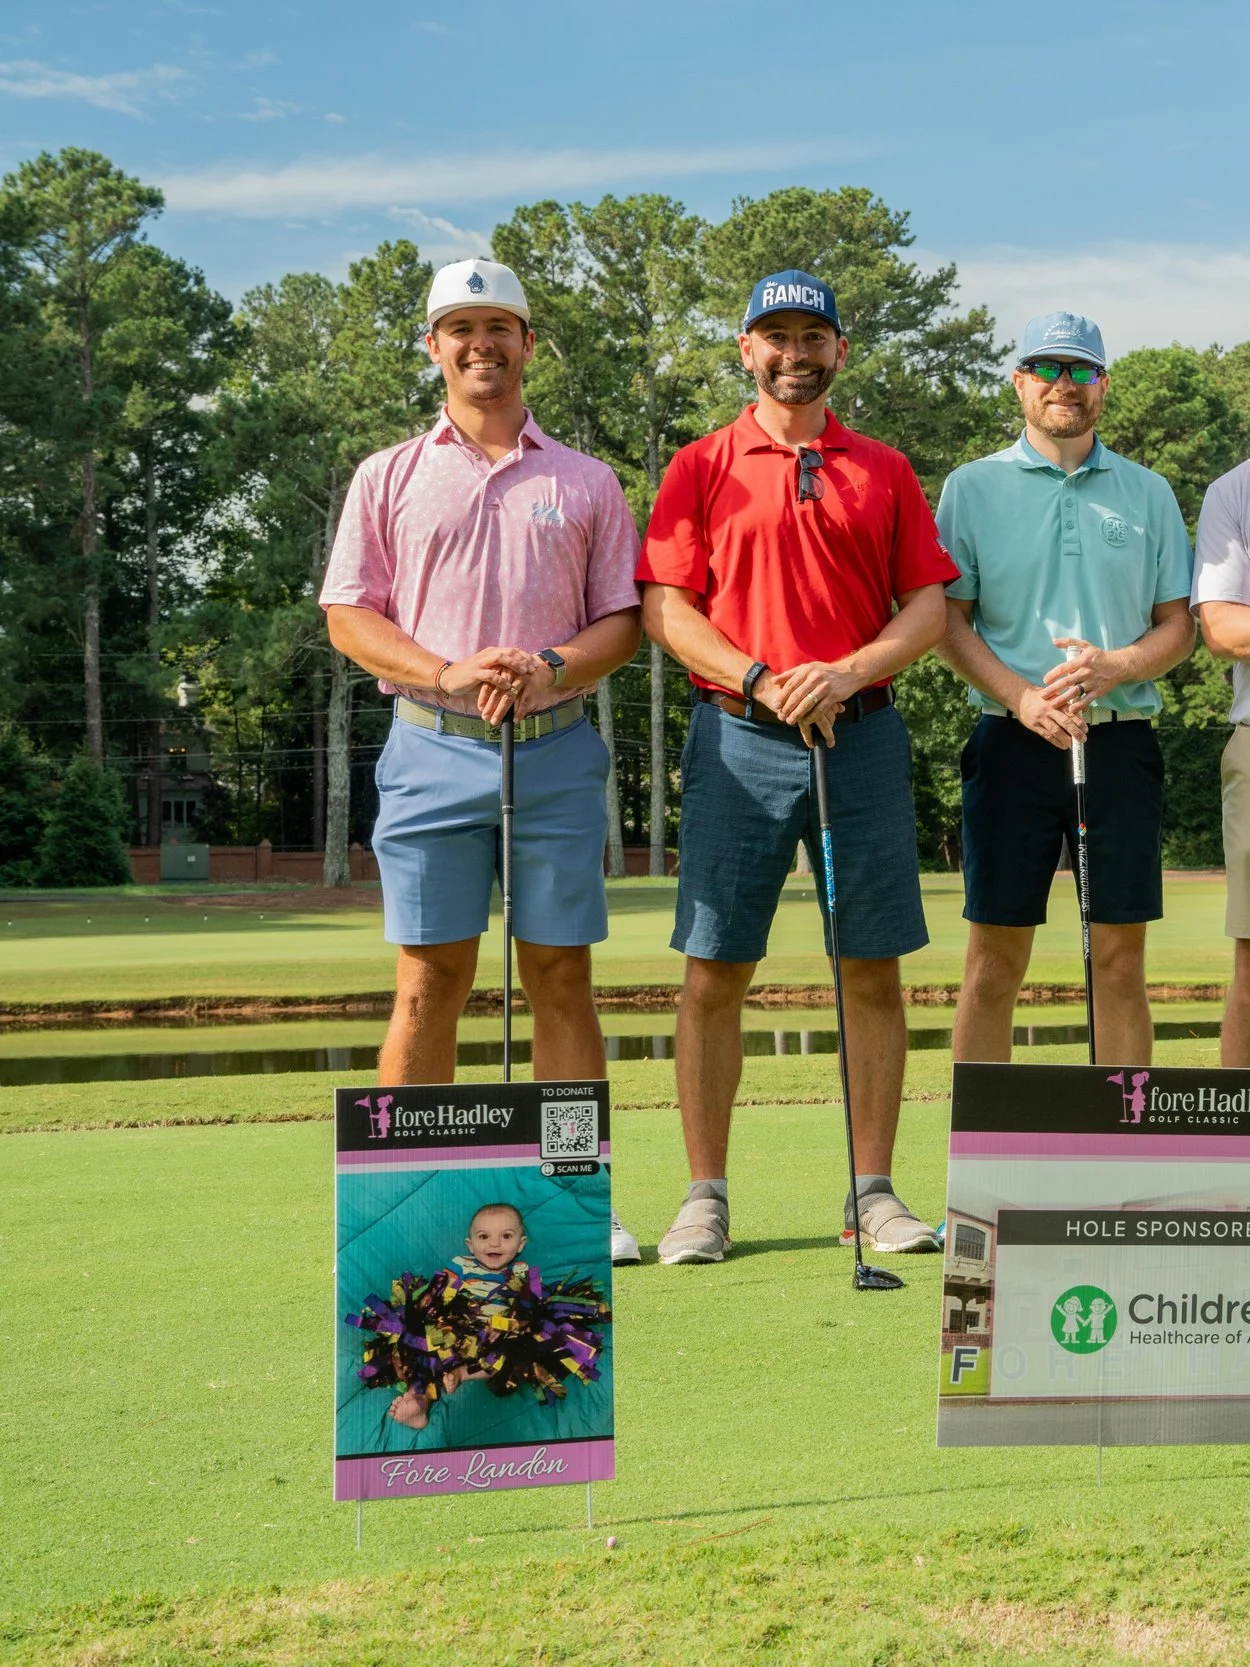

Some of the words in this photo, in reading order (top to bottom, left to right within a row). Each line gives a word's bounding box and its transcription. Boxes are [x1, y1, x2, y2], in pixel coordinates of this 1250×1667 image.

[762, 284, 825, 311] RANCH
[541, 1088, 554, 1097] TO
[556, 1087, 594, 1096] DONATE
[1149, 1115, 1181, 1124] GOLF
[1187, 1115, 1240, 1124] CLASSIC
[394, 1129, 423, 1137] GOLF
[429, 1127, 476, 1136] CLASSIC
[556, 1165, 577, 1173] SCAN
[579, 1164, 593, 1172] ME
[1065, 1220, 1127, 1238] HOLE
[1129, 1330, 1221, 1345] Healthcare
[1225, 1329, 1243, 1344] of
[380, 1457, 452, 1489] Fore
[457, 1446, 569, 1490] Landon
